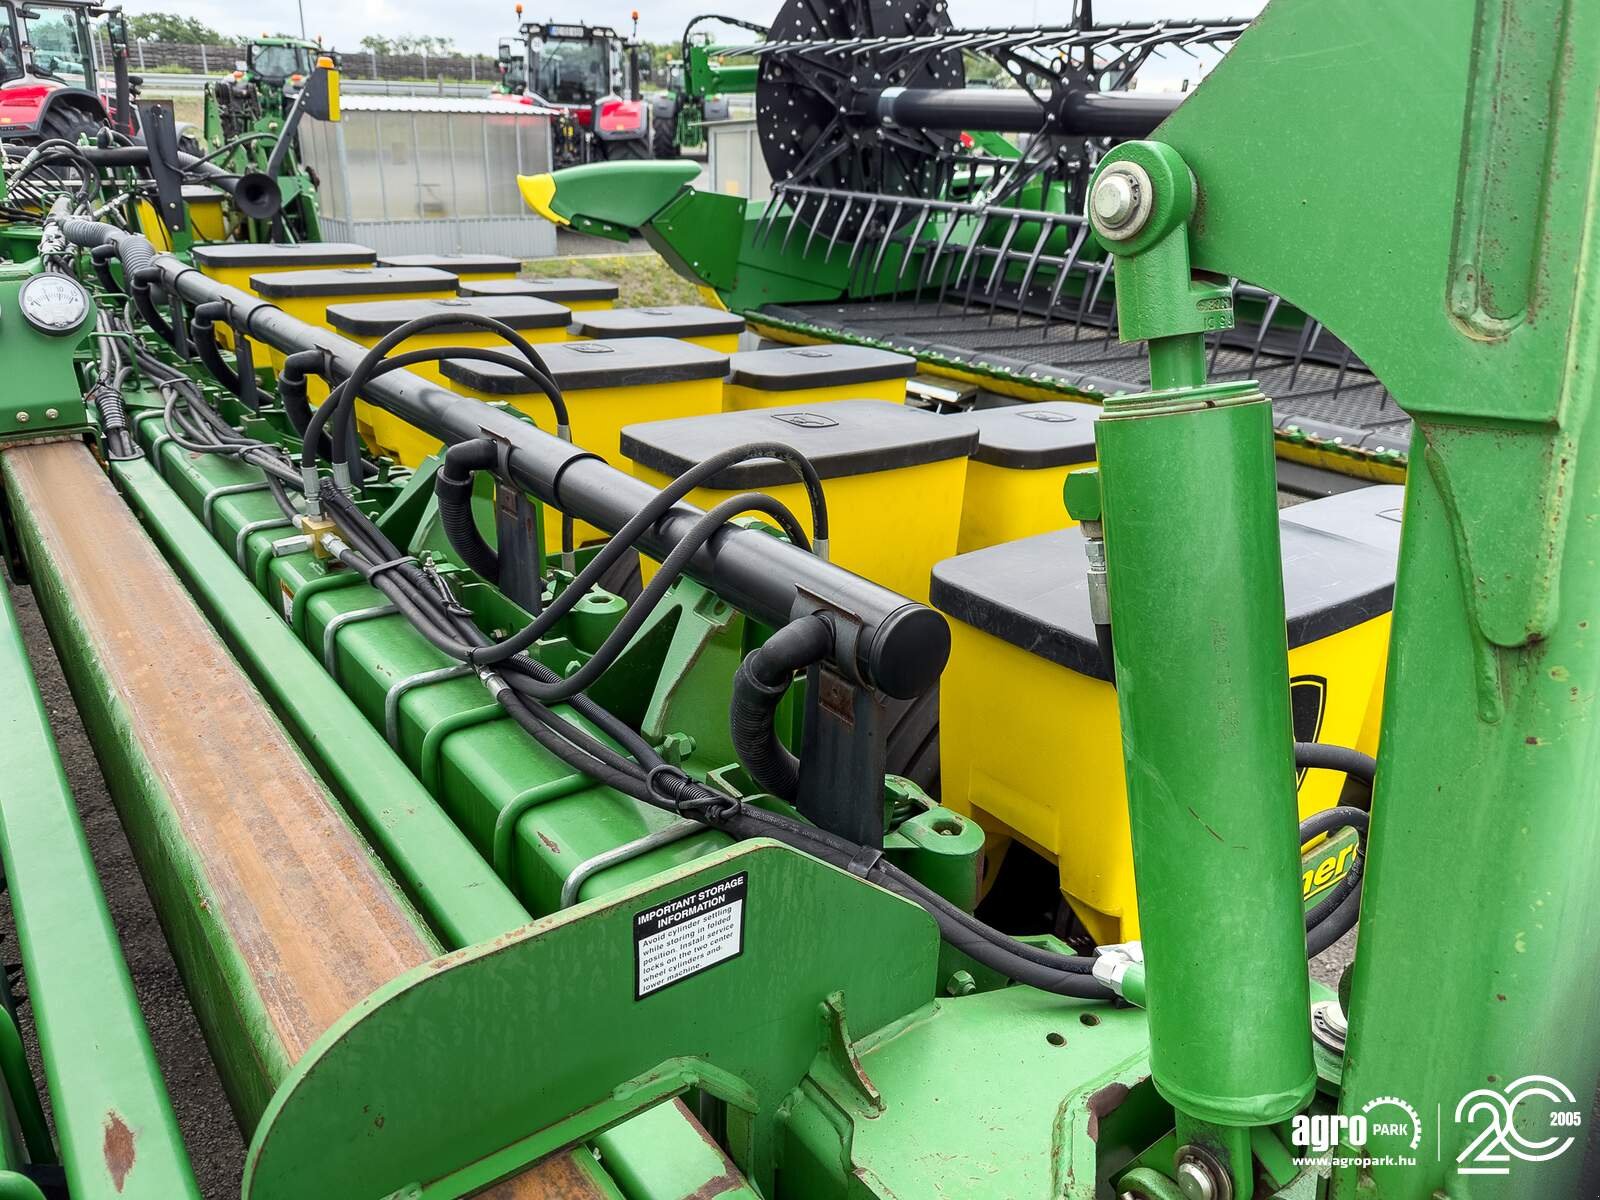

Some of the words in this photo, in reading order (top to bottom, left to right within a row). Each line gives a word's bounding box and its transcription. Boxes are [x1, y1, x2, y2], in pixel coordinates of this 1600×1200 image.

[638, 896, 696, 925] IMPORTANT
[698, 876, 743, 900] STORAGE
[658, 894, 725, 928] INFORMATION
[643, 935, 665, 947] Avoid
[668, 921, 700, 938] cylinder
[703, 906, 732, 923] settling
[643, 944, 663, 956] while
[667, 932, 694, 946] storing
[708, 915, 731, 929] folded
[680, 936, 704, 950] Install
[707, 923, 734, 937] service
[643, 962, 663, 974] locks
[679, 950, 691, 959] the
[694, 943, 707, 953] two
[710, 932, 733, 945] center
[643, 970, 665, 982] wheel
[669, 955, 704, 973] cylinders
[643, 979, 664, 991] lower
